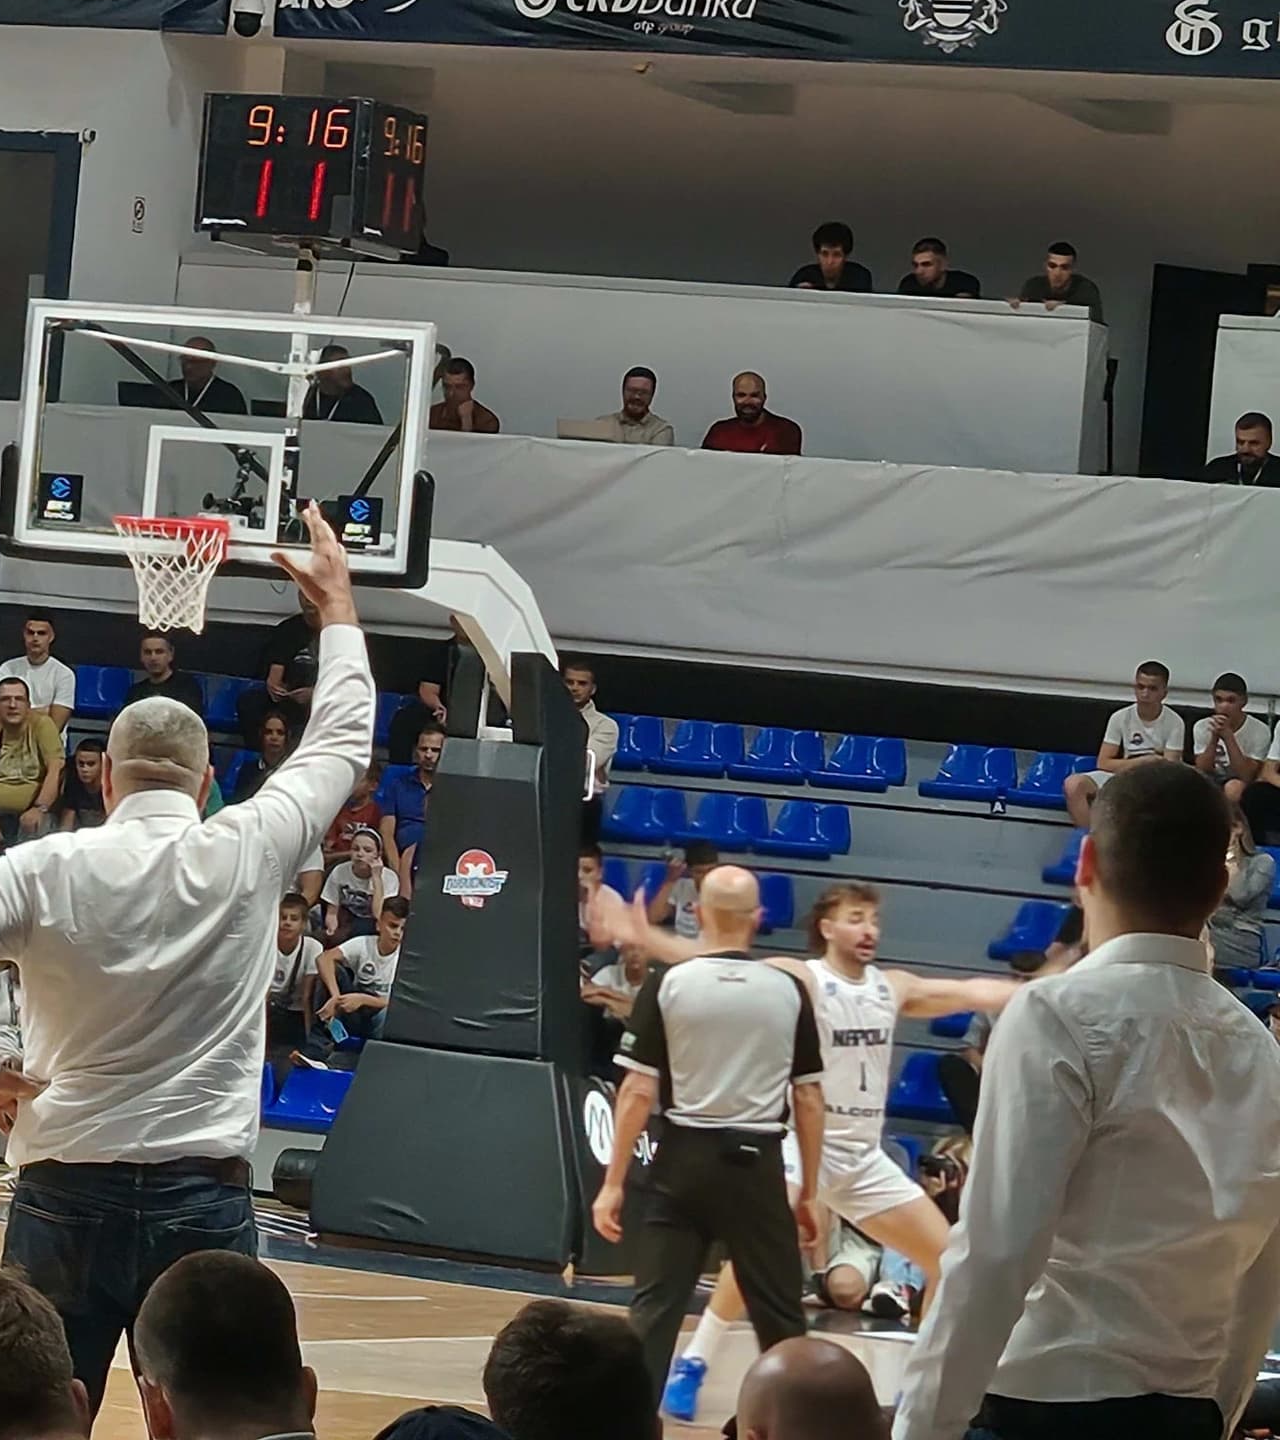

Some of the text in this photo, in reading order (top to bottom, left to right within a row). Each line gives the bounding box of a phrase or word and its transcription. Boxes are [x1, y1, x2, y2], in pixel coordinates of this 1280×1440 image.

[246, 104, 352, 149] 9:16
[383, 116, 426, 165] 9:16
[255, 159, 328, 222] 11
[992, 801, 1005, 813] A
